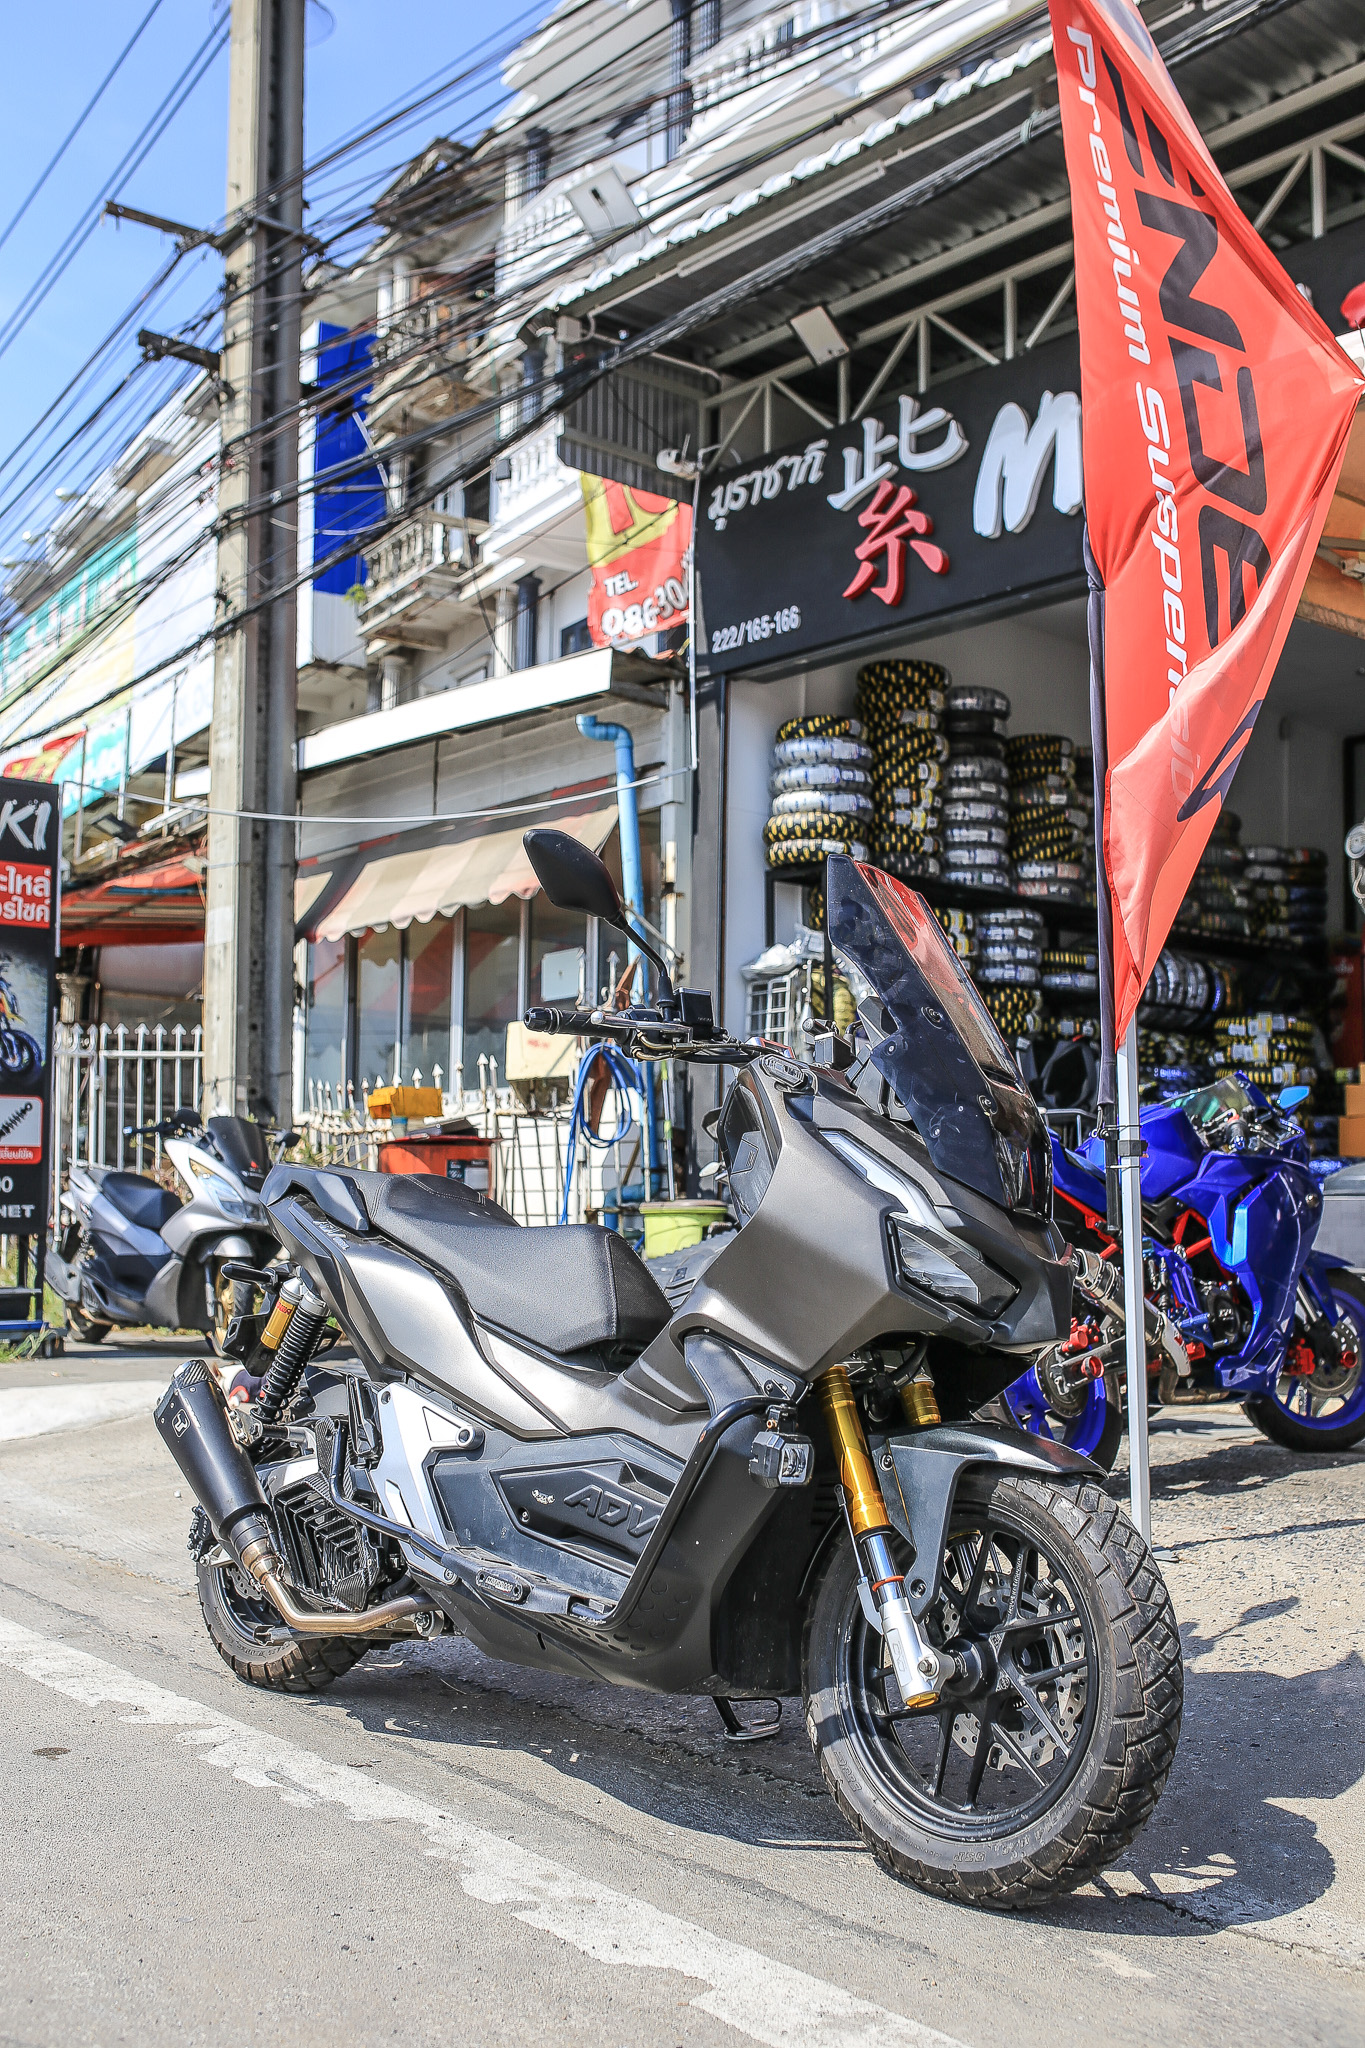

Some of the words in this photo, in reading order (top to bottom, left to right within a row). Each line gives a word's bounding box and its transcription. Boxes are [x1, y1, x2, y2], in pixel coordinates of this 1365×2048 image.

[1066, 25, 1151, 365] Premium
[603, 570, 639, 598] TEL.
[711, 605, 802, 654] 222/165-166
[0, 894, 51, 923] รไซค์
[563, 1484, 662, 1538] ADV
